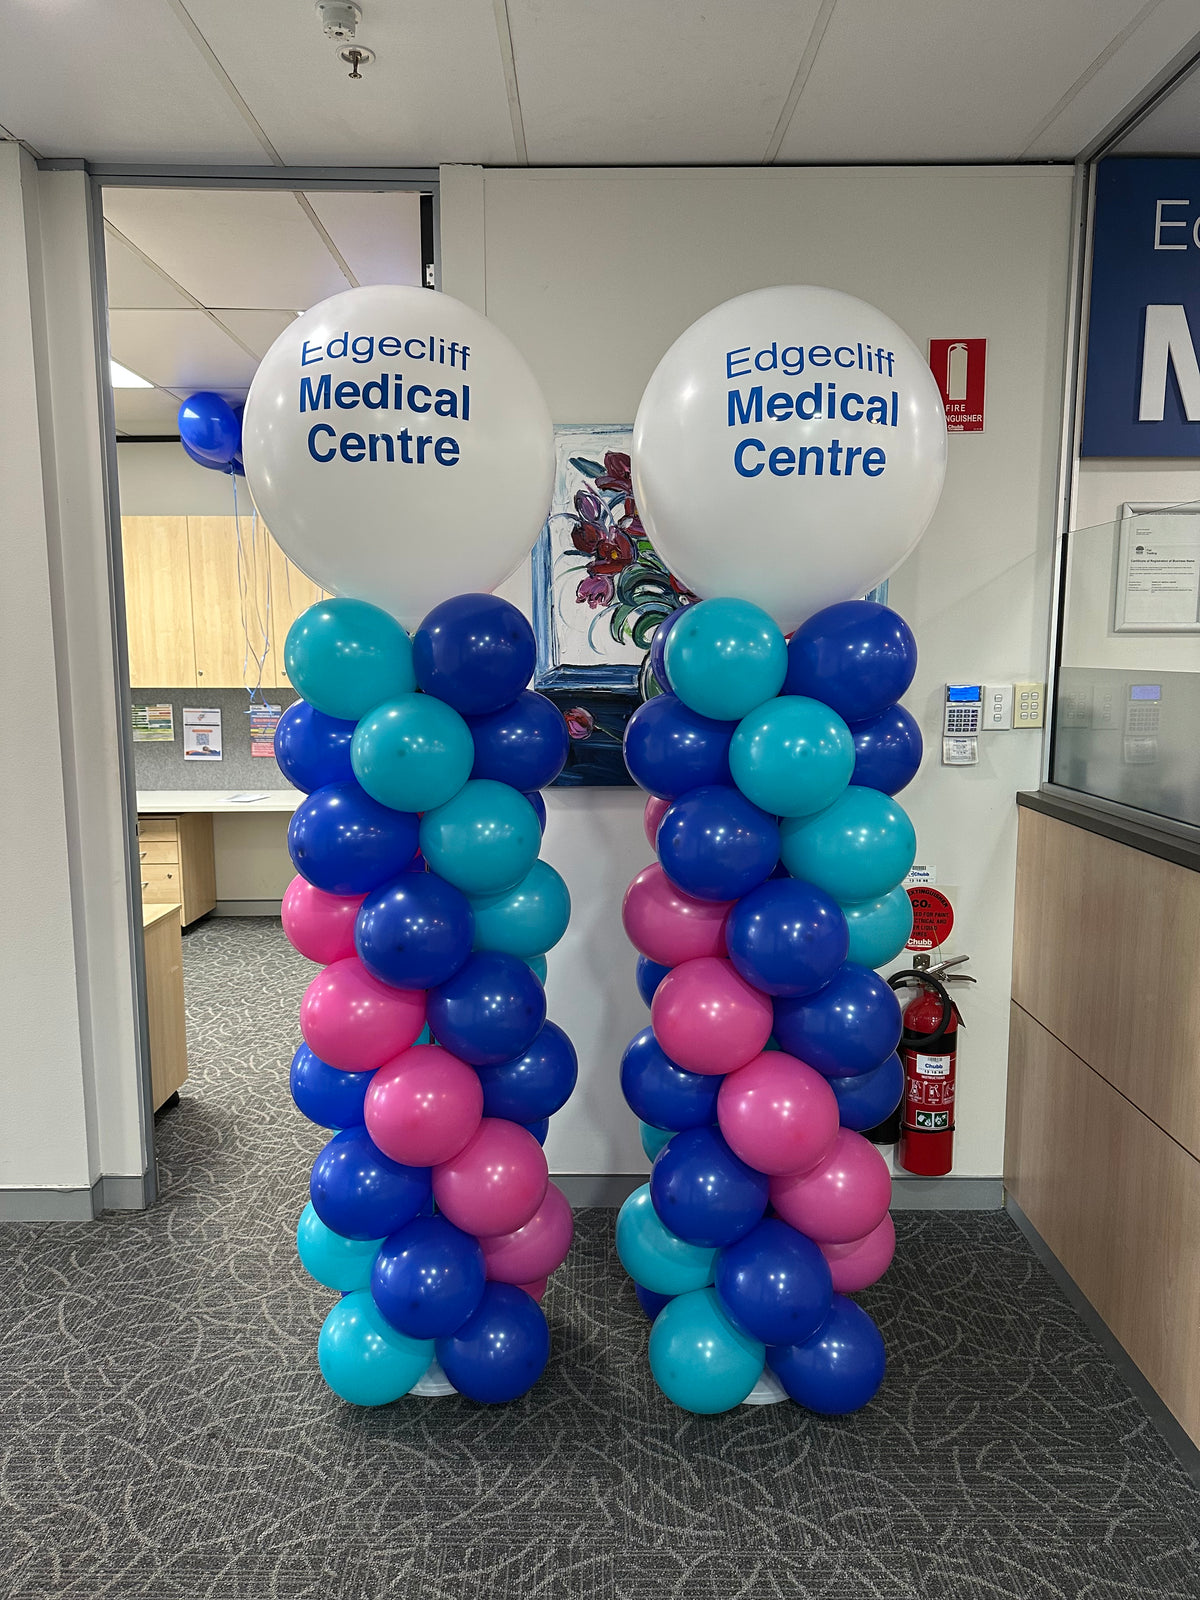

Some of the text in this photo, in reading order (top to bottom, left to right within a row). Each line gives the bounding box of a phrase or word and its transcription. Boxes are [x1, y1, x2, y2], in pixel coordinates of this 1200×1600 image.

[1154, 199, 1200, 250] E
[301, 331, 470, 371] Edgecliff
[726, 342, 895, 379] Edgecliff
[299, 373, 470, 421] Medical
[728, 382, 898, 427] Medical
[945, 404, 966, 412] FIRE
[945, 414, 983, 422] NGUISHER
[307, 423, 460, 466] Centre
[734, 438, 886, 478] Centre
